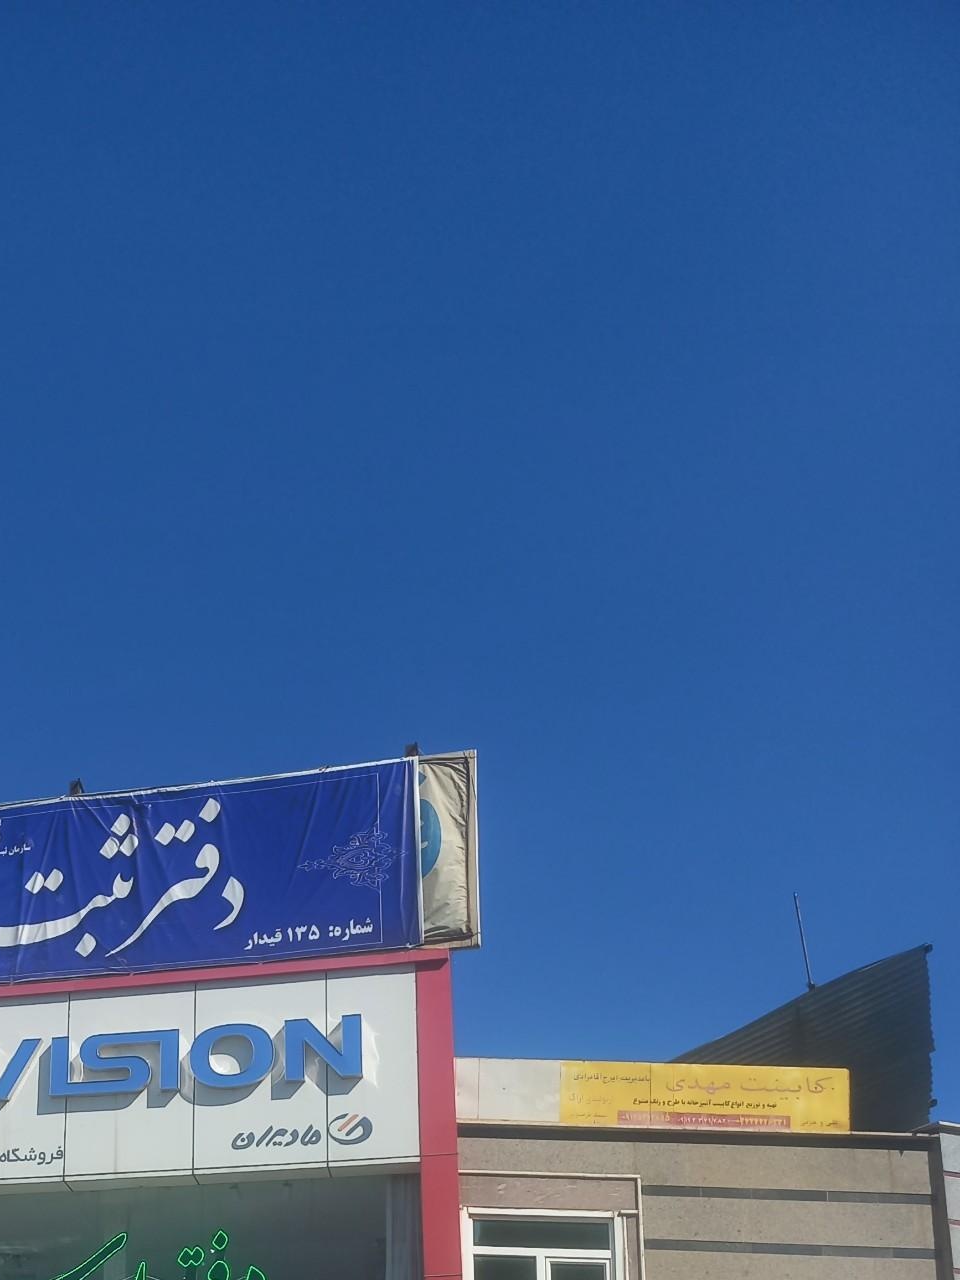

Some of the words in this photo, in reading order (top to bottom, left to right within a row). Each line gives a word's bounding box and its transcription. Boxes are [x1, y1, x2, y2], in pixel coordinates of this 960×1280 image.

[105, 797, 245, 958] دفتر
[243, 928, 283, 950] قیدار
[287, 923, 320, 942] ۱۳۵
[665, 1078, 732, 1095] مهدی
[231, 1123, 322, 1151] مادیران
